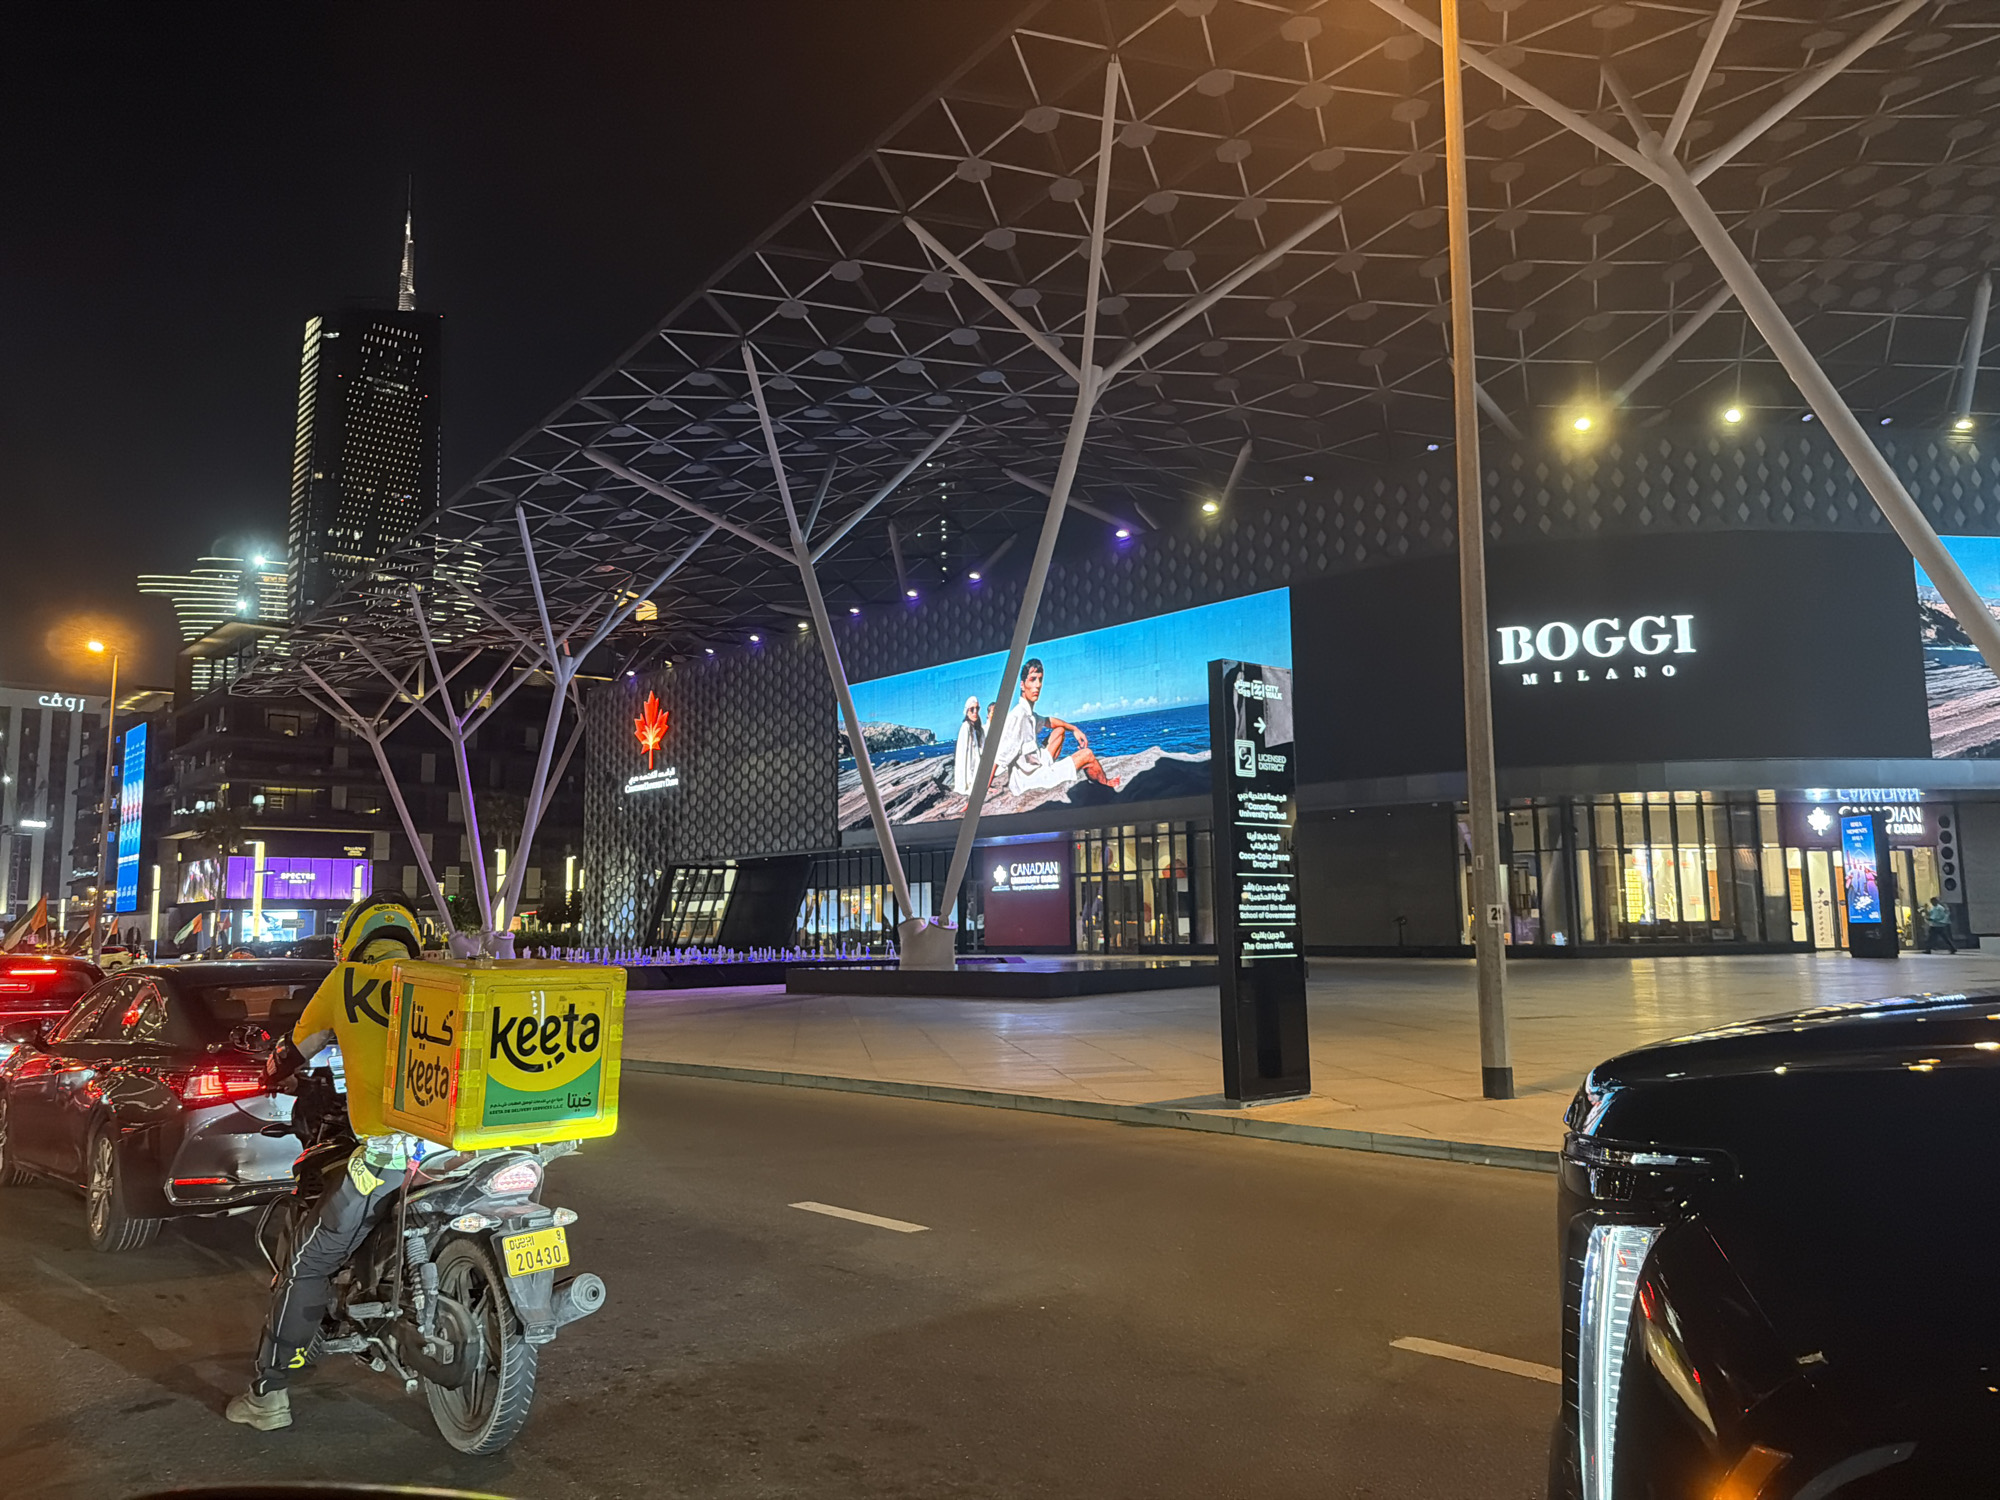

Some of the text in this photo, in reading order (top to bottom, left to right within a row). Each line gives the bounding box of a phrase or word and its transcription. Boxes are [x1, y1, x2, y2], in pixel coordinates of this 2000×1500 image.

[1496, 614, 1697, 665] BOGGI
[1522, 665, 1676, 685] MILANO
[1265, 692, 1283, 700] WALK
[1258, 753, 1287, 764] LICENSED
[1258, 763, 1285, 772] DISTRICT
[1248, 802, 1278, 812] Canadian
[1238, 810, 1287, 820] University Dubai
[1239, 851, 1290, 861] Coca-Cola Arena
[1010, 861, 1059, 877] CANADIAN
[1252, 860, 1278, 869] Drop-off
[1243, 941, 1294, 950] The Green Planet
[411, 1000, 454, 1050] كيتا
[489, 1003, 601, 1073] keeta
[406, 1049, 450, 1107] keeta
[567, 1092, 592, 1112] كيتا
[516, 1245, 561, 1272] 20430
